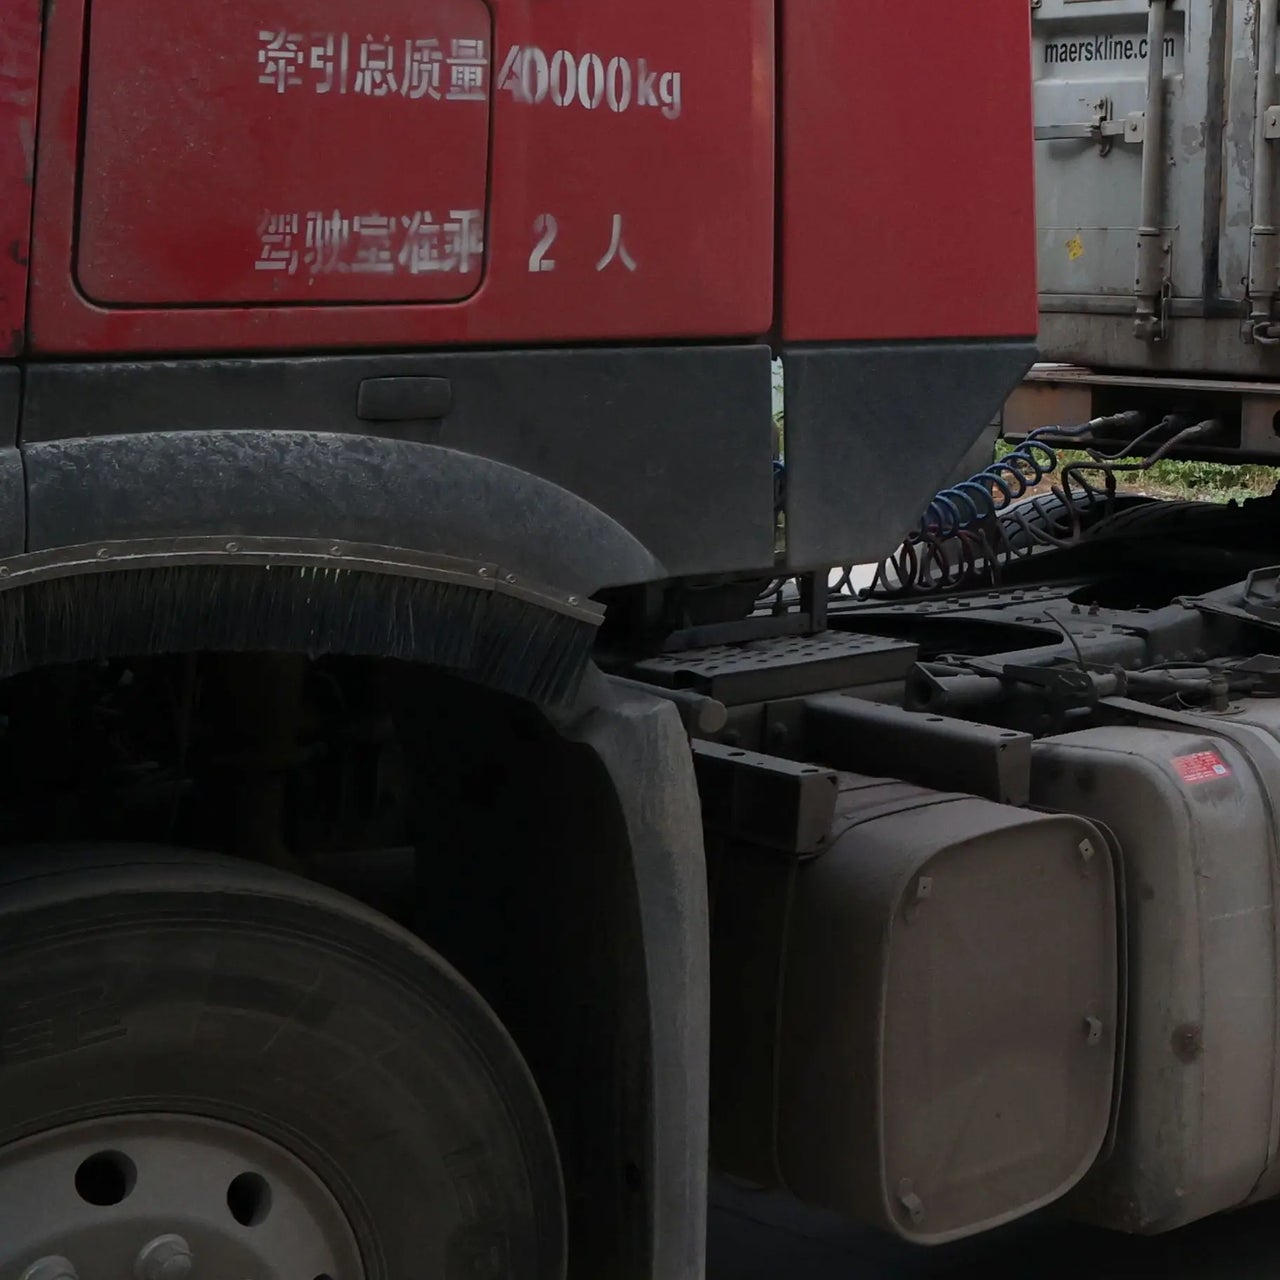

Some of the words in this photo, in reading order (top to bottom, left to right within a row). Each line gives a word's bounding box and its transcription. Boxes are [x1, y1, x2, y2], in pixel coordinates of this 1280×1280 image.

[257, 28, 488, 101] 牵引总质量
[1044, 34, 1175, 64] maerskline.cm
[528, 213, 558, 272] 2
[595, 213, 637, 272] 人
